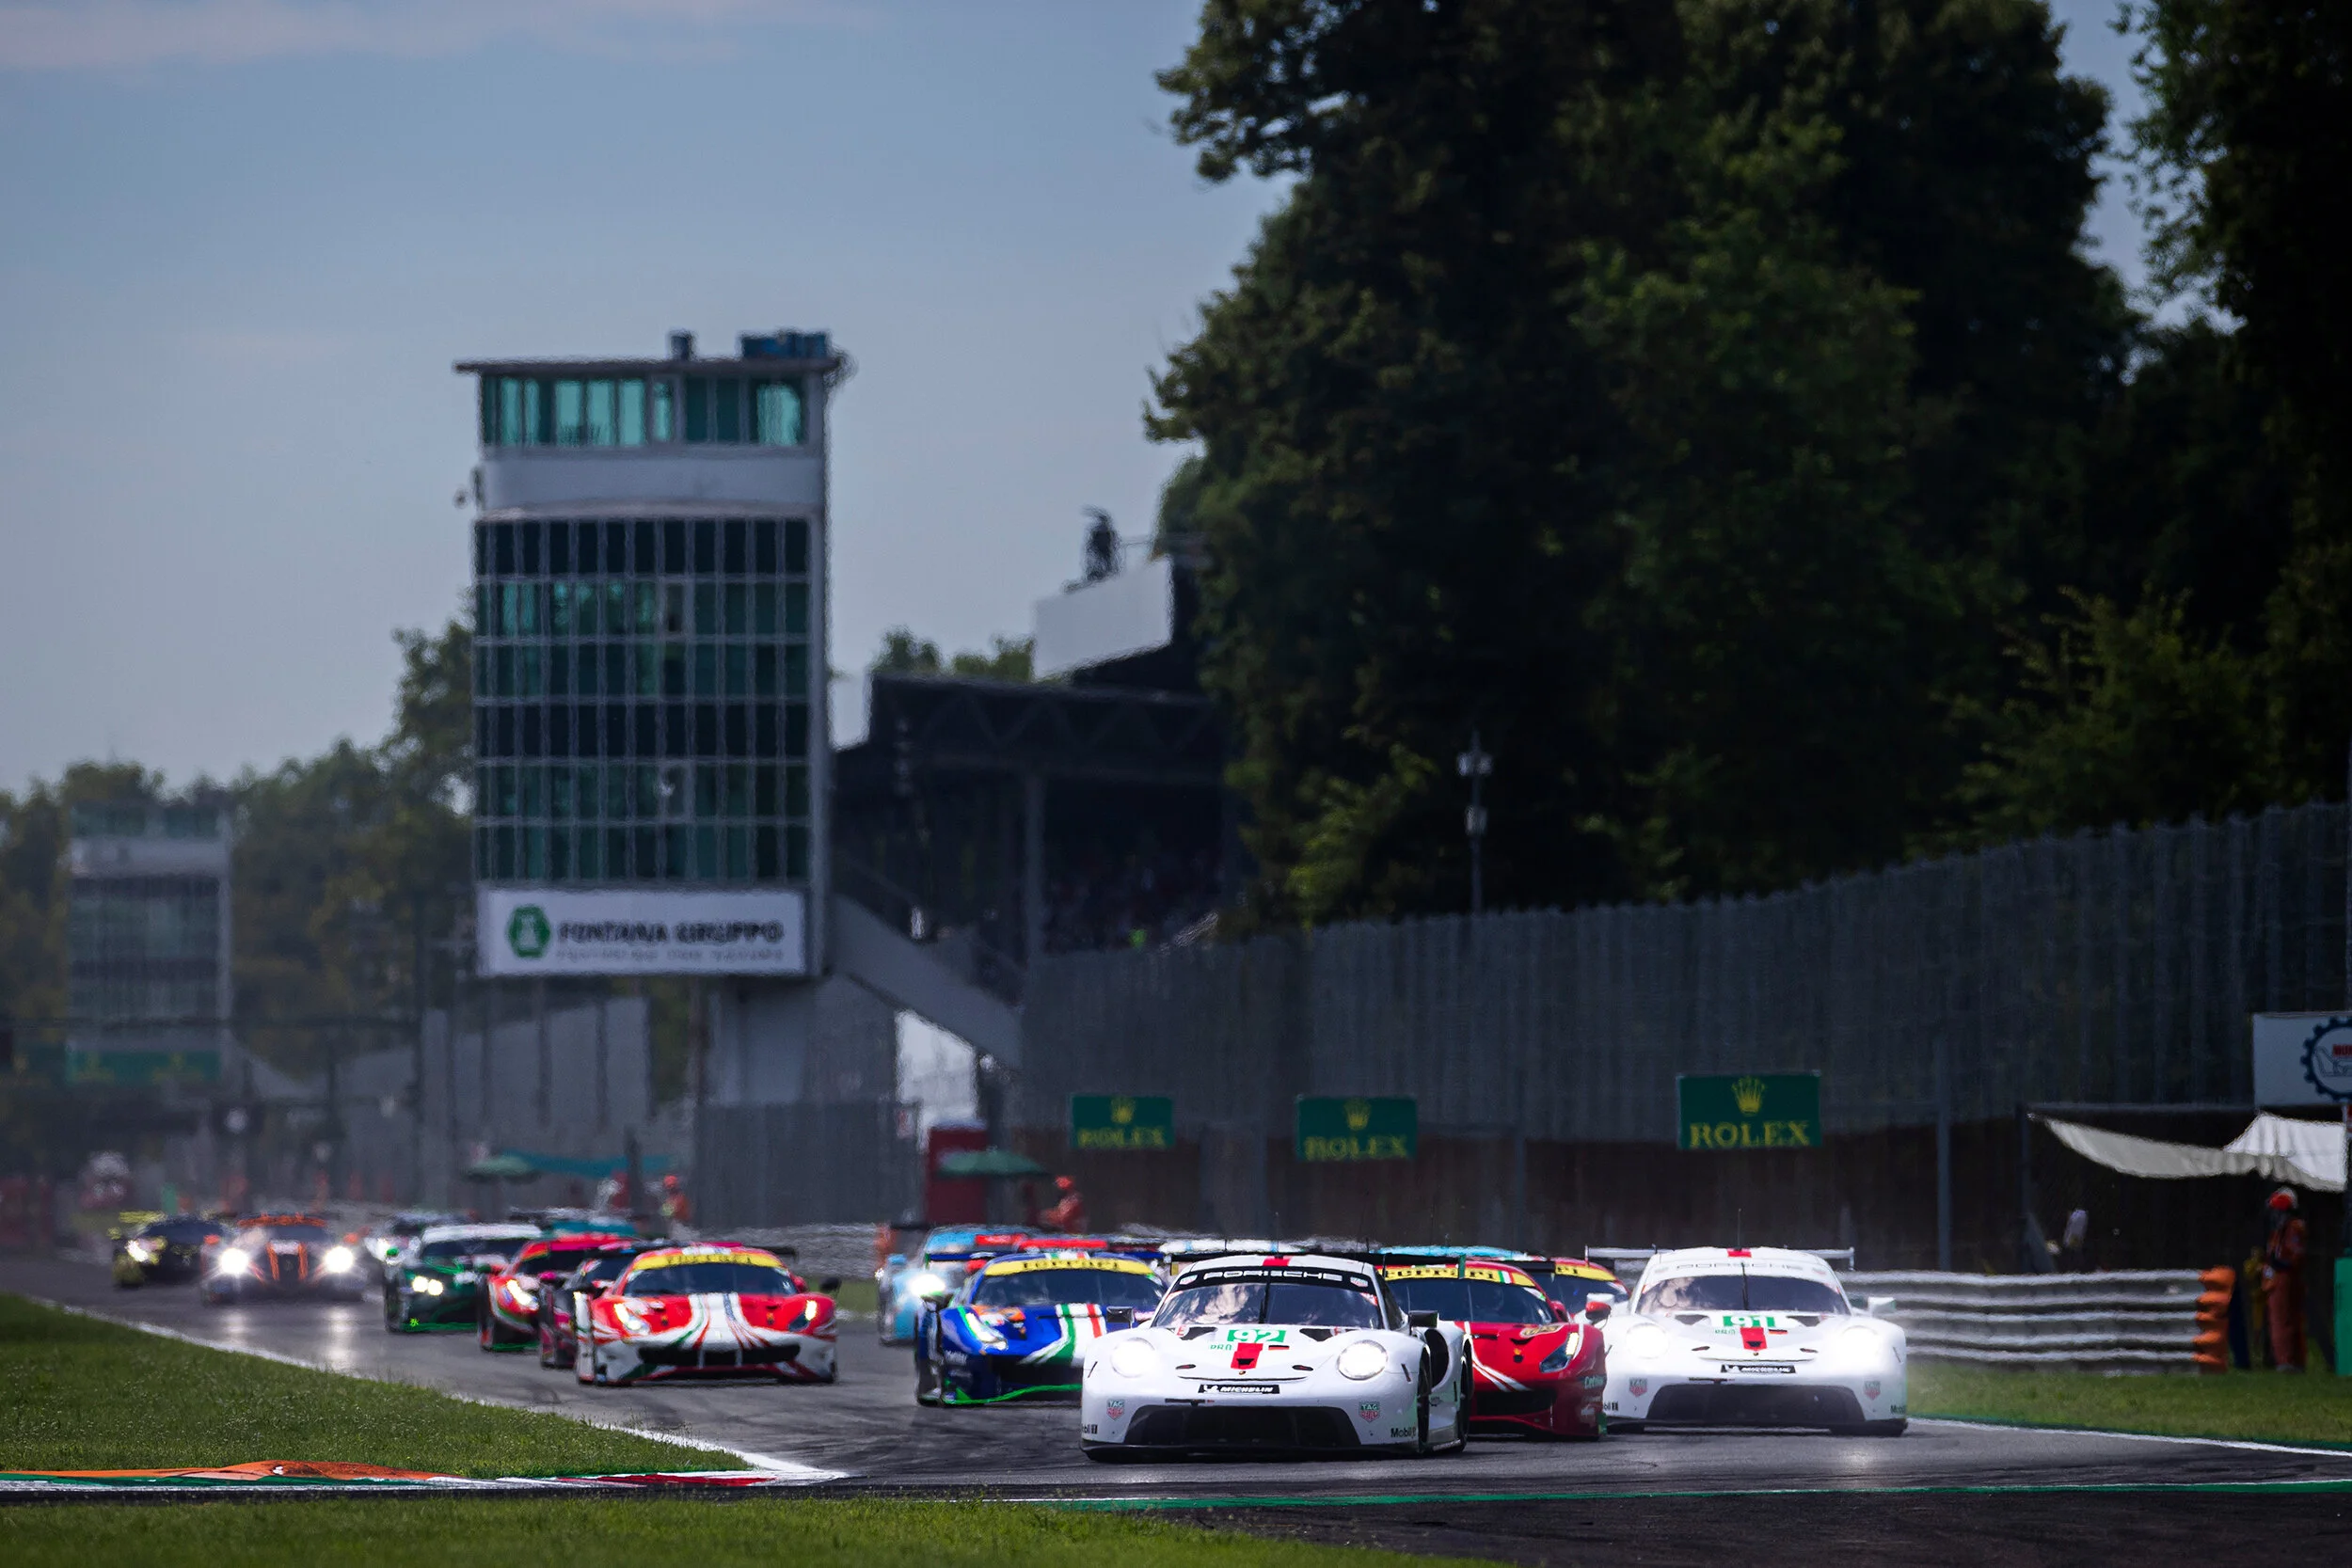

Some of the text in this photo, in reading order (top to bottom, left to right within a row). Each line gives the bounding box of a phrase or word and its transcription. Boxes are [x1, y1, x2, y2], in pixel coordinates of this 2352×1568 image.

[559, 920, 786, 943] FONTANA GRUPPO
[1077, 1128, 1166, 1147] ROLEX
[1689, 1120, 1811, 1148] ROLEX
[1303, 1134, 1408, 1160] ROLEX
[1203, 1271, 1343, 1281] PORSCHE
[1730, 1316, 1768, 1327] 91
[1233, 1329, 1280, 1342] 92
[1220, 1385, 1274, 1393] MICHELIN
